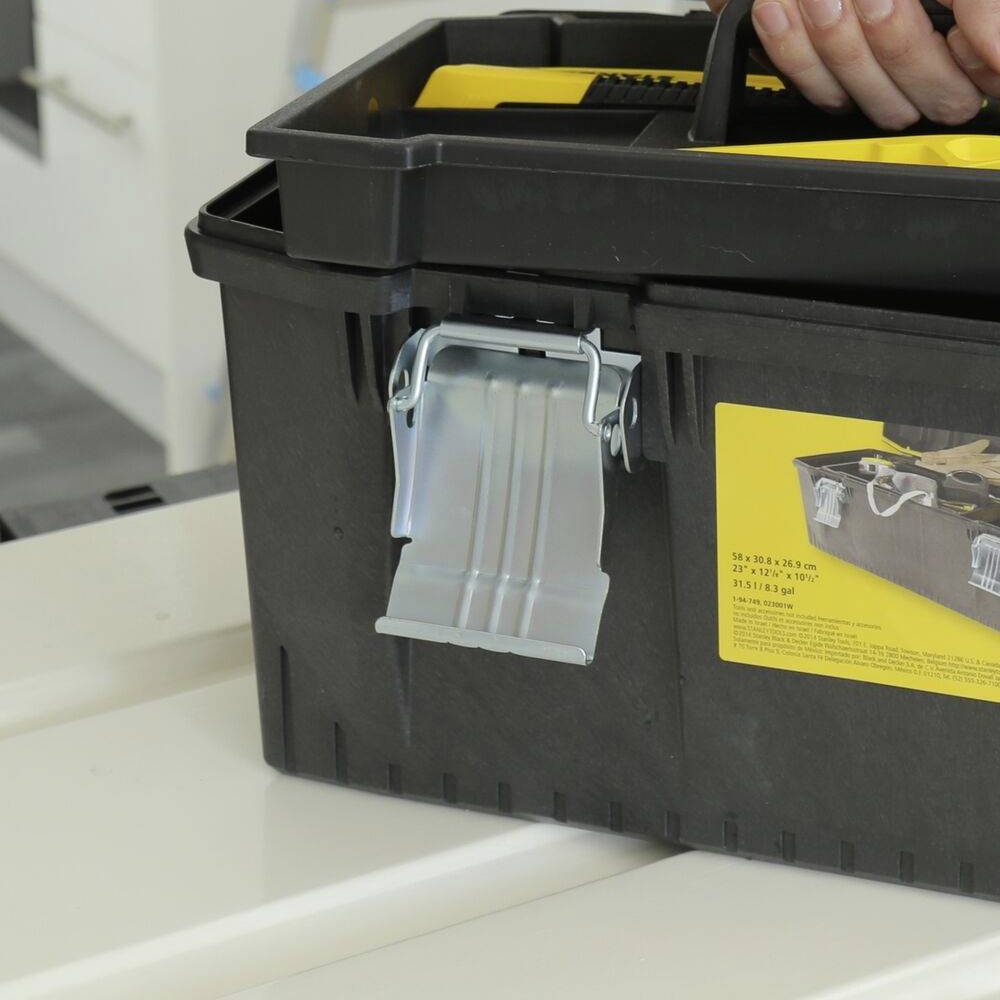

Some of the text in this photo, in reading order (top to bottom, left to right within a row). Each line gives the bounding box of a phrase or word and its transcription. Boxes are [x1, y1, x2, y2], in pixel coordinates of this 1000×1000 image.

[732, 551, 743, 561] 58
[753, 554, 772, 565] 30.8
[774, 559, 780, 567] x
[782, 559, 801, 570] 26.9
[803, 563, 817, 572] cm
[733, 578, 751, 589] 31.5
[764, 582, 778, 593] 8.3
[780, 585, 794, 597] gal
